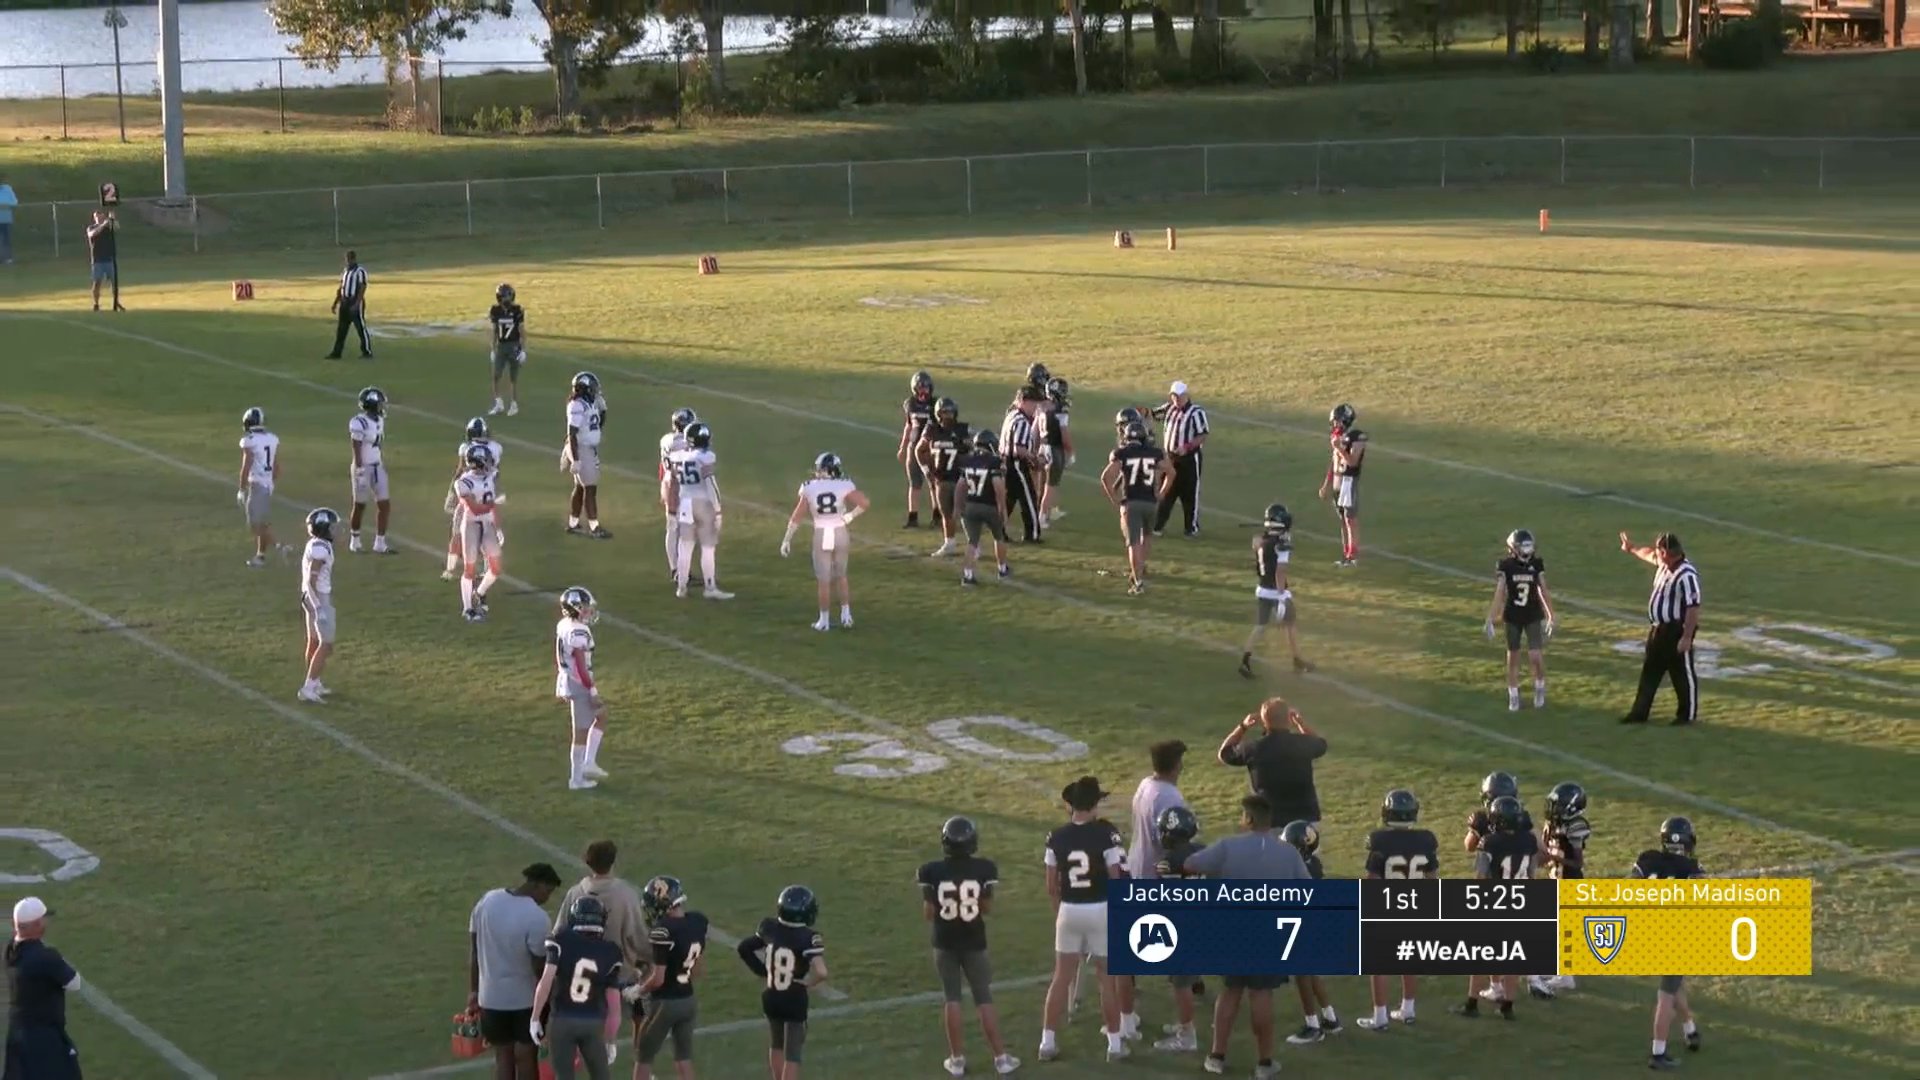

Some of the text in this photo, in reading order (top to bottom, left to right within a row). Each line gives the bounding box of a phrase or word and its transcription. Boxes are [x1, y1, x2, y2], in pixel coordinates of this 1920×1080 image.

[103, 183, 117, 202] 2
[702, 256, 719, 273] 10
[235, 283, 253, 299] 20
[498, 324, 514, 340] 17
[264, 446, 272, 472] 1
[931, 449, 958, 471] 77
[1126, 457, 1155, 486] 75
[816, 492, 838, 514] 8
[1513, 583, 1531, 607] 3
[781, 716, 1090, 778] 30
[1067, 850, 1092, 888] 2
[1500, 855, 1530, 879] 14
[765, 943, 794, 991] 18
[571, 957, 598, 1003] 6
